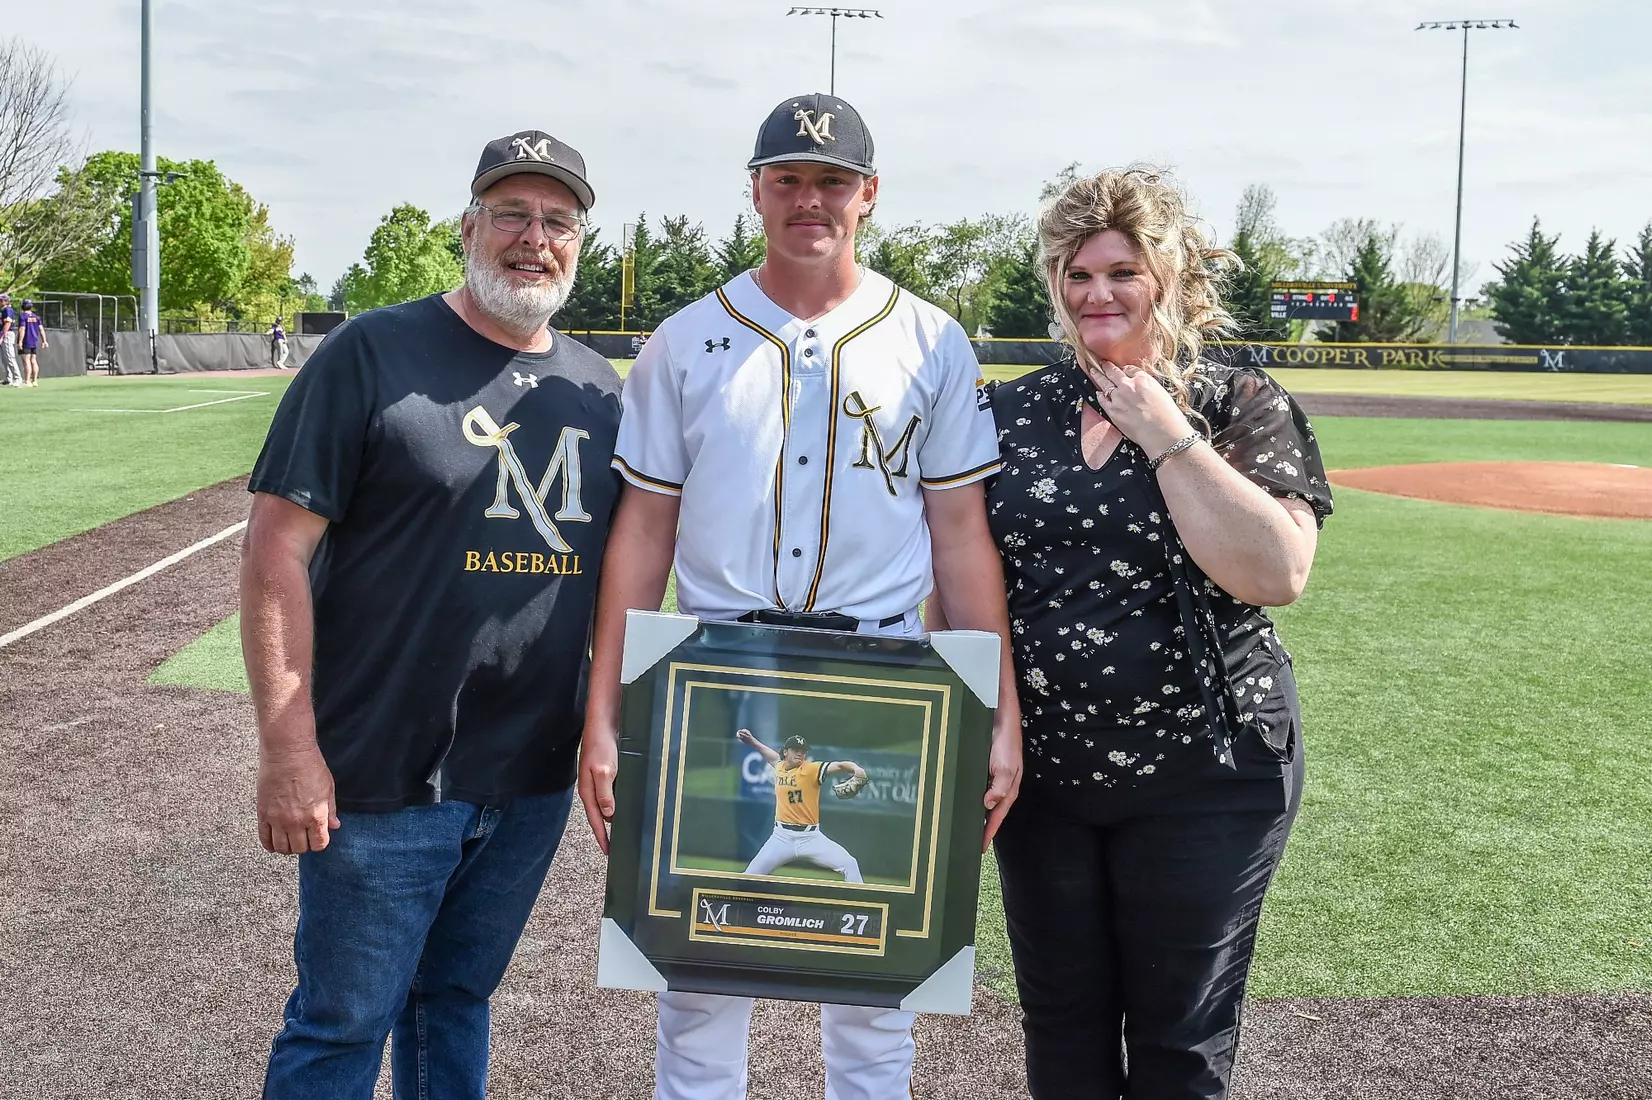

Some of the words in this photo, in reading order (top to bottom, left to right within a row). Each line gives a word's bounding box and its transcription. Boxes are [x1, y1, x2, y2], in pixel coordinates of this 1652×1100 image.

[1273, 347, 1372, 368] COOPER
[1377, 348, 1451, 369] PARK
[464, 550, 583, 576] BASEBALL
[787, 789, 803, 804] 27
[757, 906, 784, 915] COLBY
[756, 914, 825, 929] GROMLICH
[840, 913, 869, 935] 27
